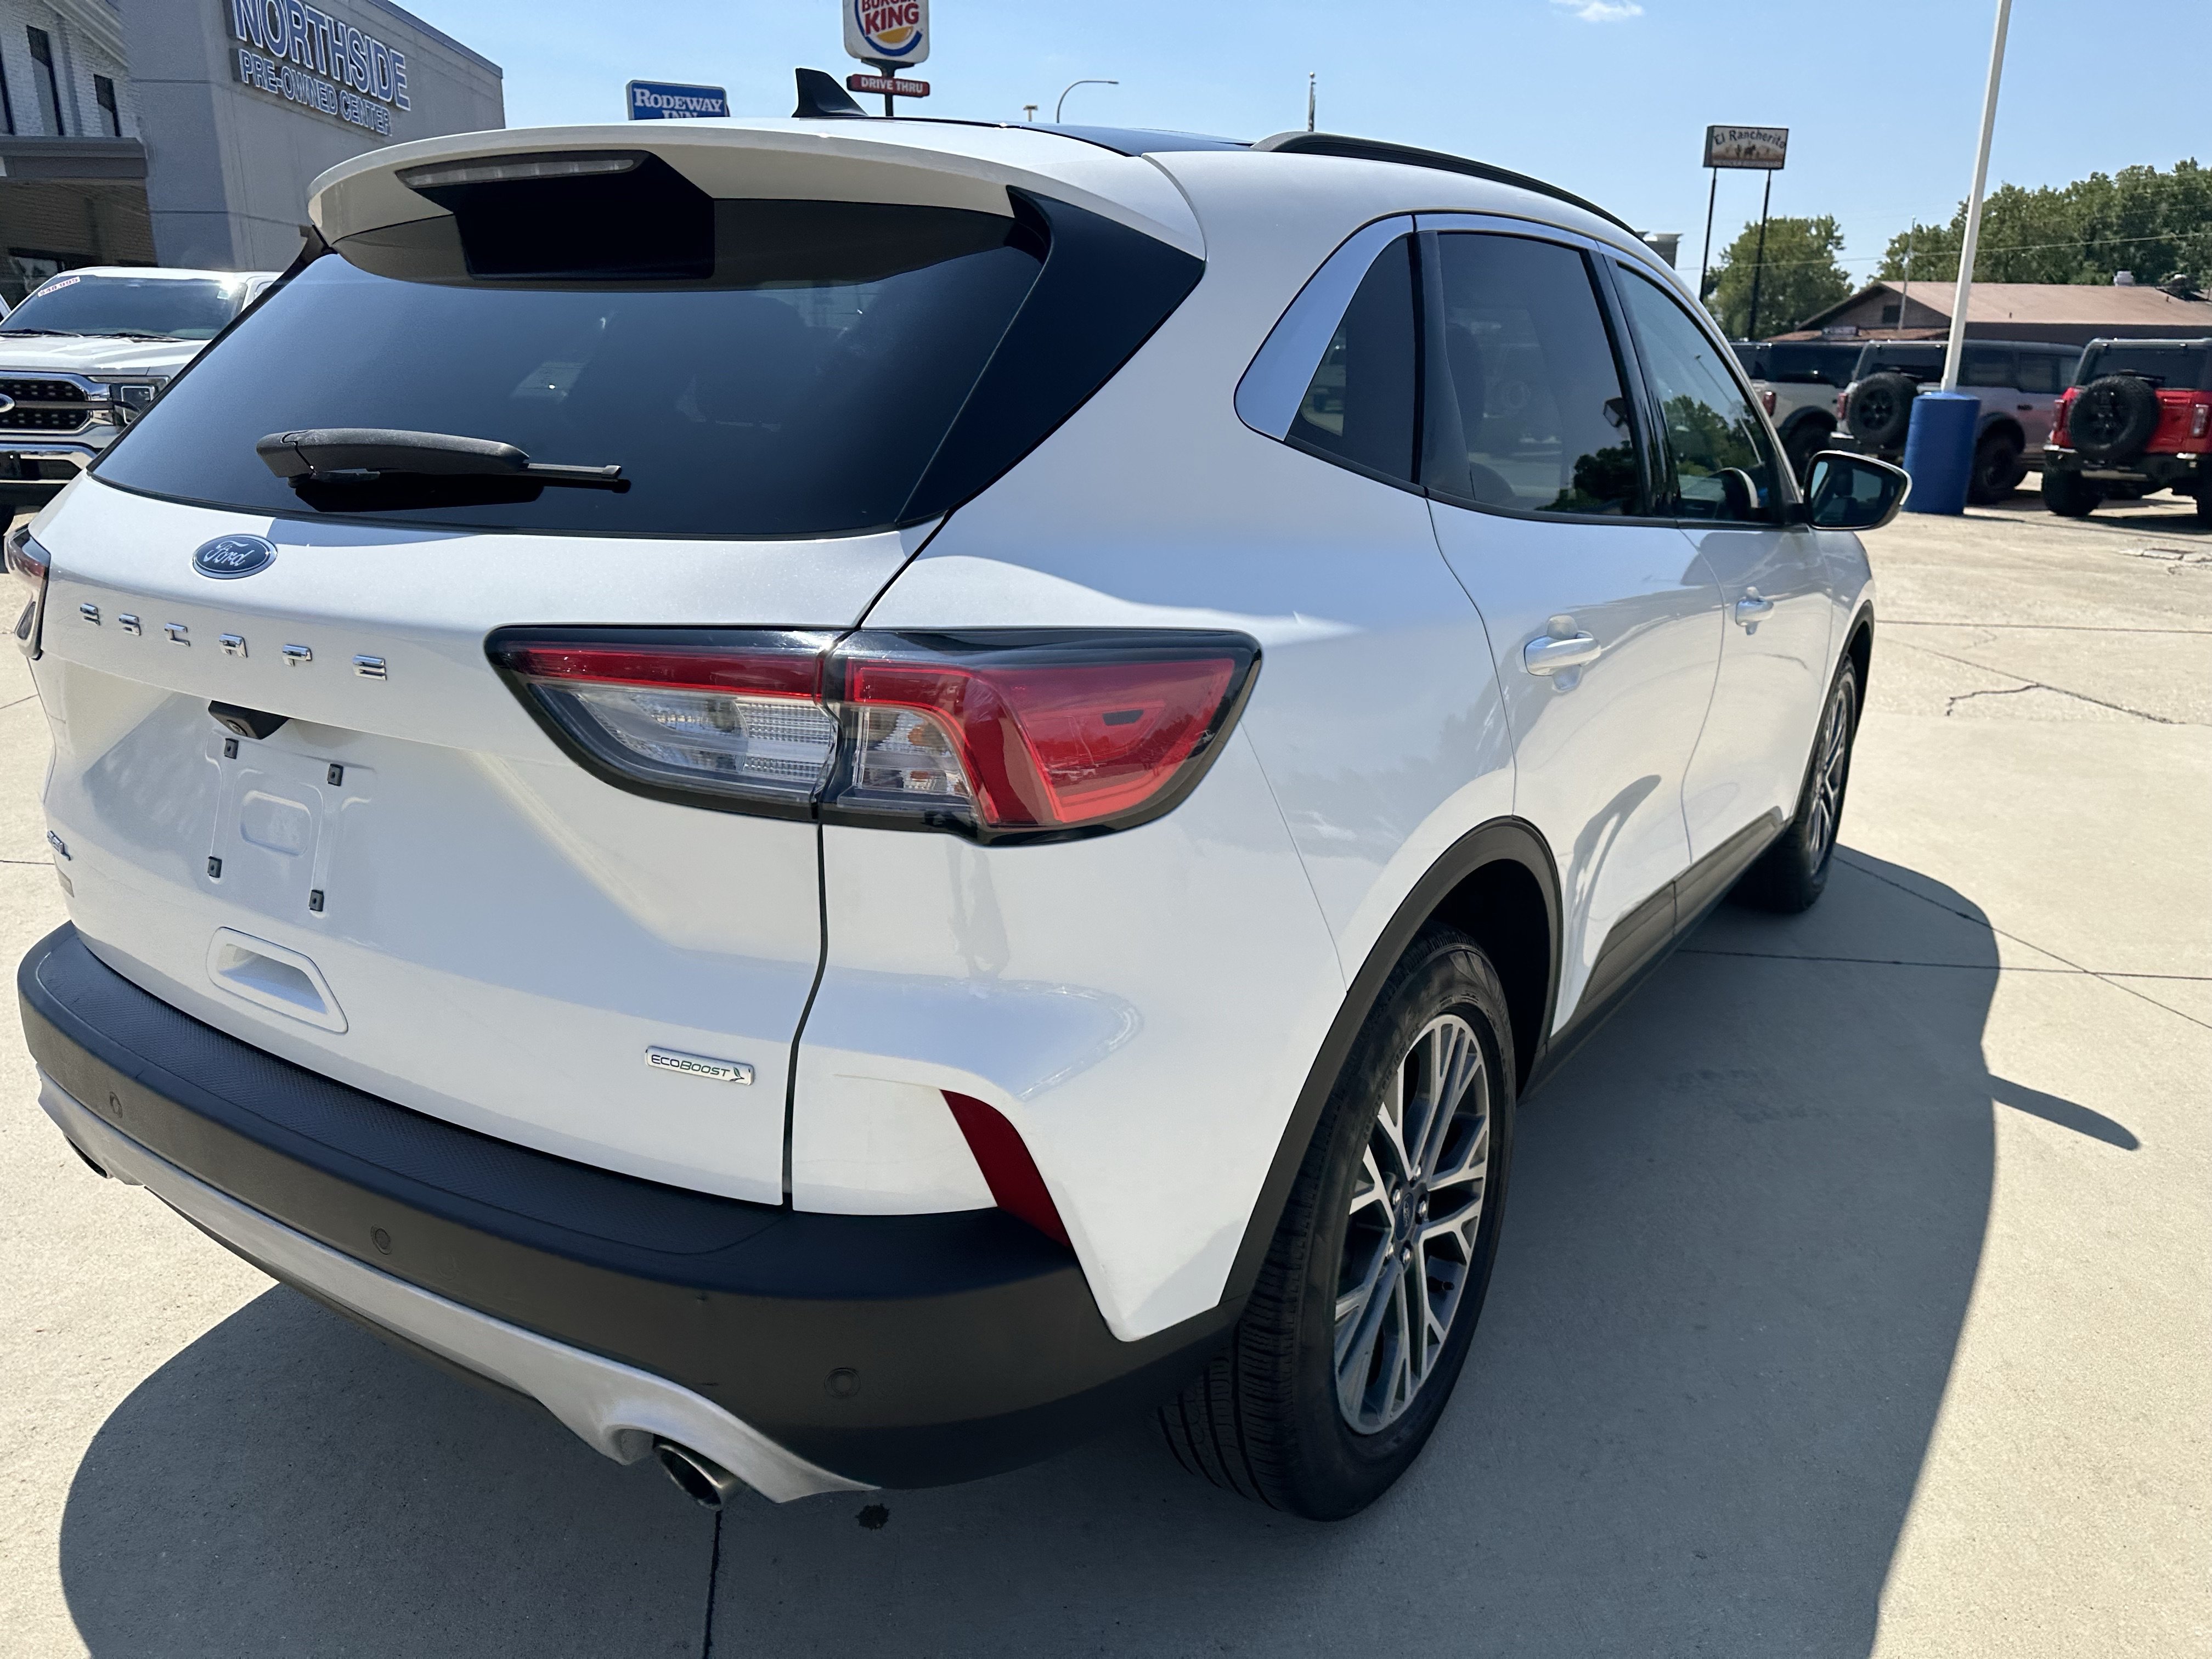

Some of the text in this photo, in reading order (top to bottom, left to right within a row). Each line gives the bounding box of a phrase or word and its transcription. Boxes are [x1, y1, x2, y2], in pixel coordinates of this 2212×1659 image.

[865, 3, 919, 35] KING
[232, 0, 411, 111] NORTHSIDE
[239, 48, 392, 136] PRE-OWNED CENTER
[861, 77, 923, 93] DRIVE THRU
[1714, 133, 1725, 145] El
[203, 540, 255, 566] Ford
[651, 1054, 731, 1077] ECOBOOST
